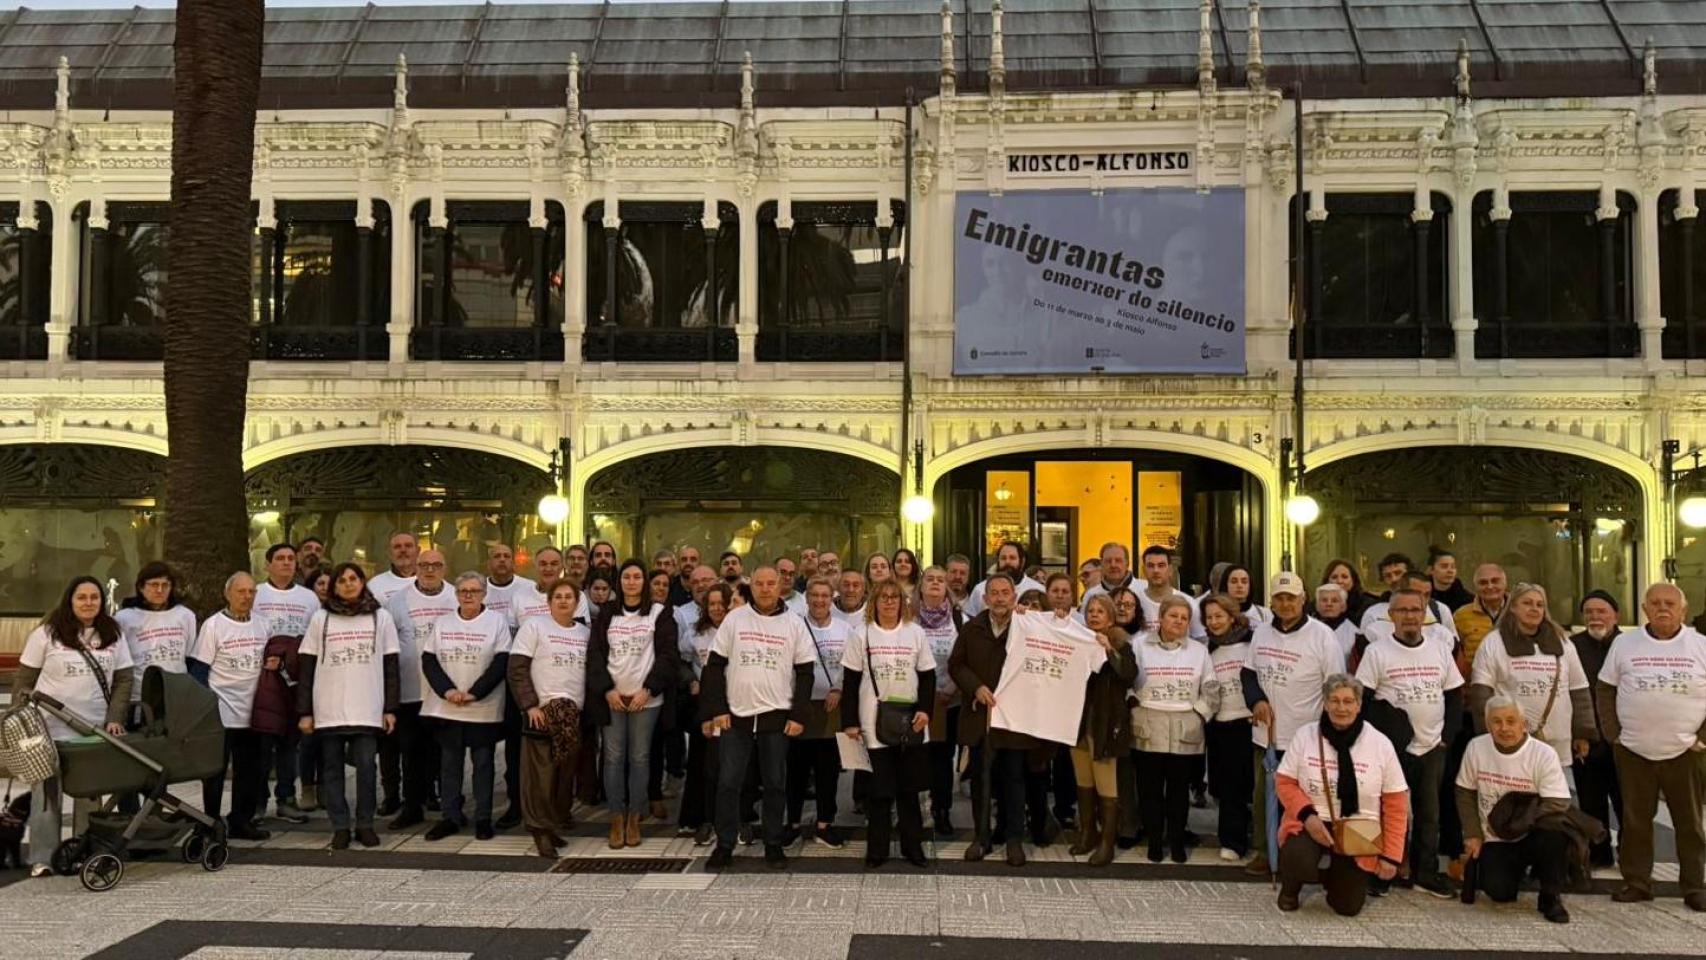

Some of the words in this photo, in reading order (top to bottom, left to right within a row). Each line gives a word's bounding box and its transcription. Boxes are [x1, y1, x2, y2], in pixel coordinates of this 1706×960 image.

[1008, 152, 1189, 172] KIOSCO-ALFONSO
[964, 208, 1165, 289] Emigrantas
[1042, 268, 1125, 301] emerxer
[1128, 290, 1152, 309] do
[1156, 300, 1235, 333] silencio
[1055, 304, 1066, 314] de
[1068, 309, 1093, 321] marzo
[1113, 320, 1124, 330] de
[1117, 308, 1144, 322] Kiosco
[1146, 316, 1177, 331] Alfonso
[1253, 432, 1262, 444] 3
